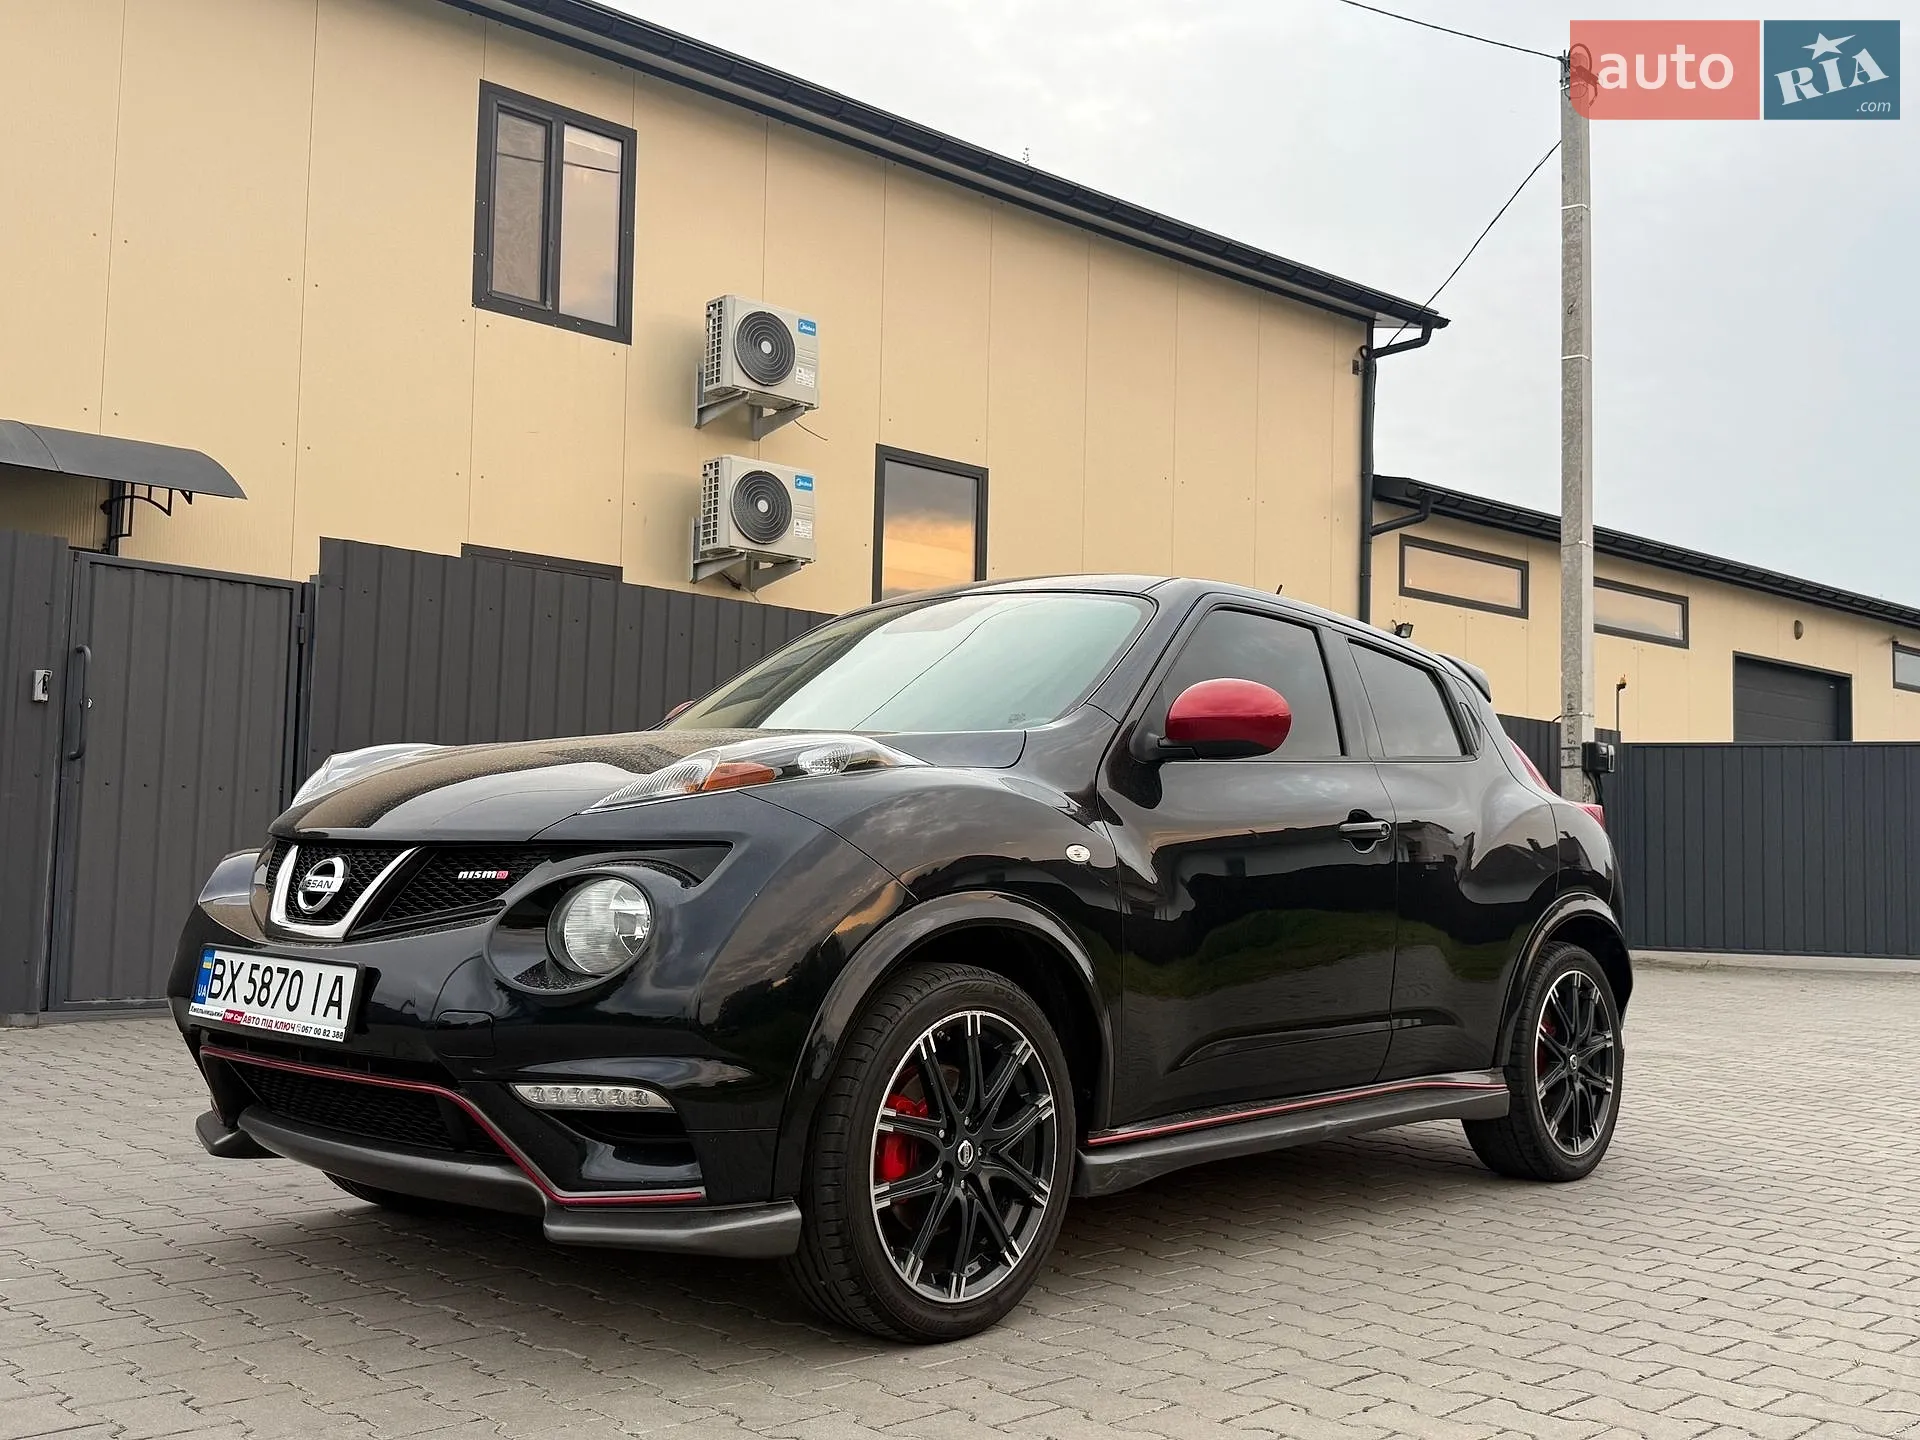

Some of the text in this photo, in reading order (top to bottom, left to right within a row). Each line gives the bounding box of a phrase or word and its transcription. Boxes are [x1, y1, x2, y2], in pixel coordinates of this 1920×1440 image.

[197, 983, 207, 997] UA
[208, 958, 344, 1020] BX 5870 IA
[242, 1014, 296, 1032] АВТО ПІД КЛЮЧ
[301, 1025, 313, 1034] 067
[314, 1027, 321, 1035] 00
[322, 1028, 331, 1038] 82
